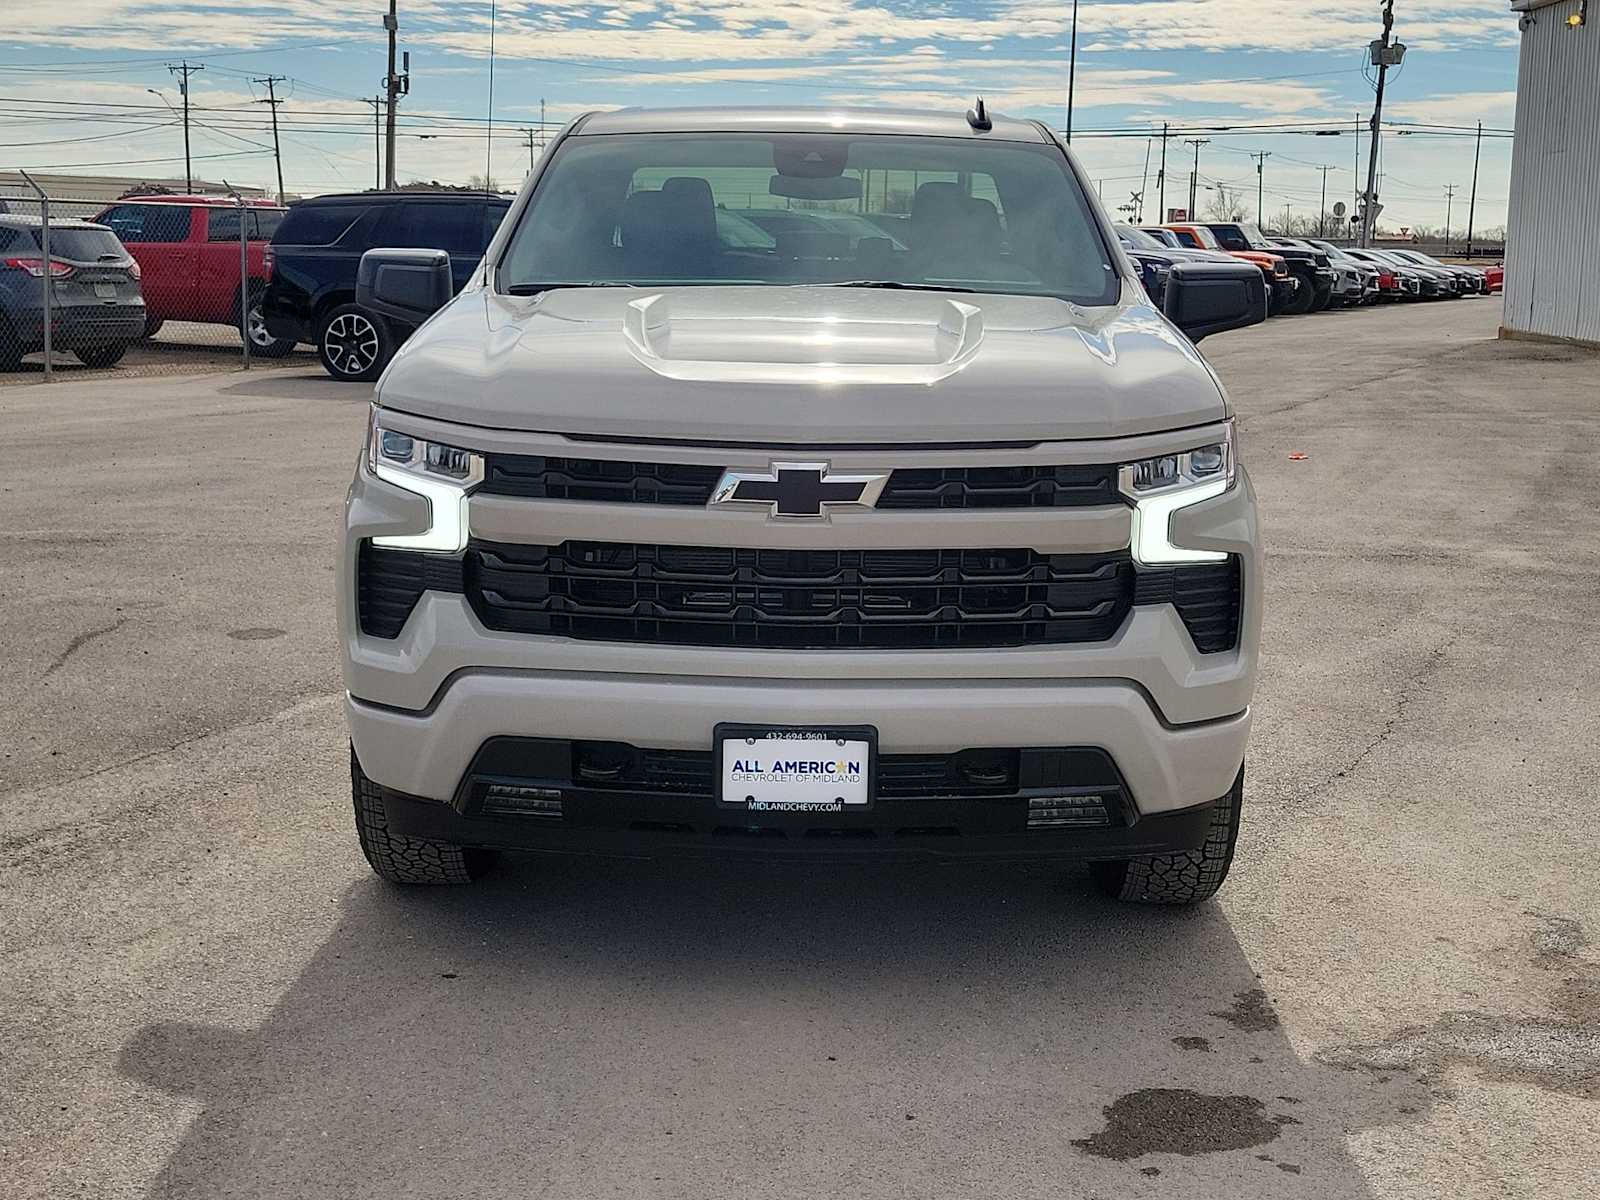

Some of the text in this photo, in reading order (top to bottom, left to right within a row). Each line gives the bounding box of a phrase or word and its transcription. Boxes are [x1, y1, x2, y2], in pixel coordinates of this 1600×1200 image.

[766, 732, 827, 741] 432-694-9601
[732, 760, 764, 773] ALL
[731, 773, 860, 783] CHEVROLET OF MIDLAND
[748, 801, 842, 812] MIDLANDCHEVY.COM
